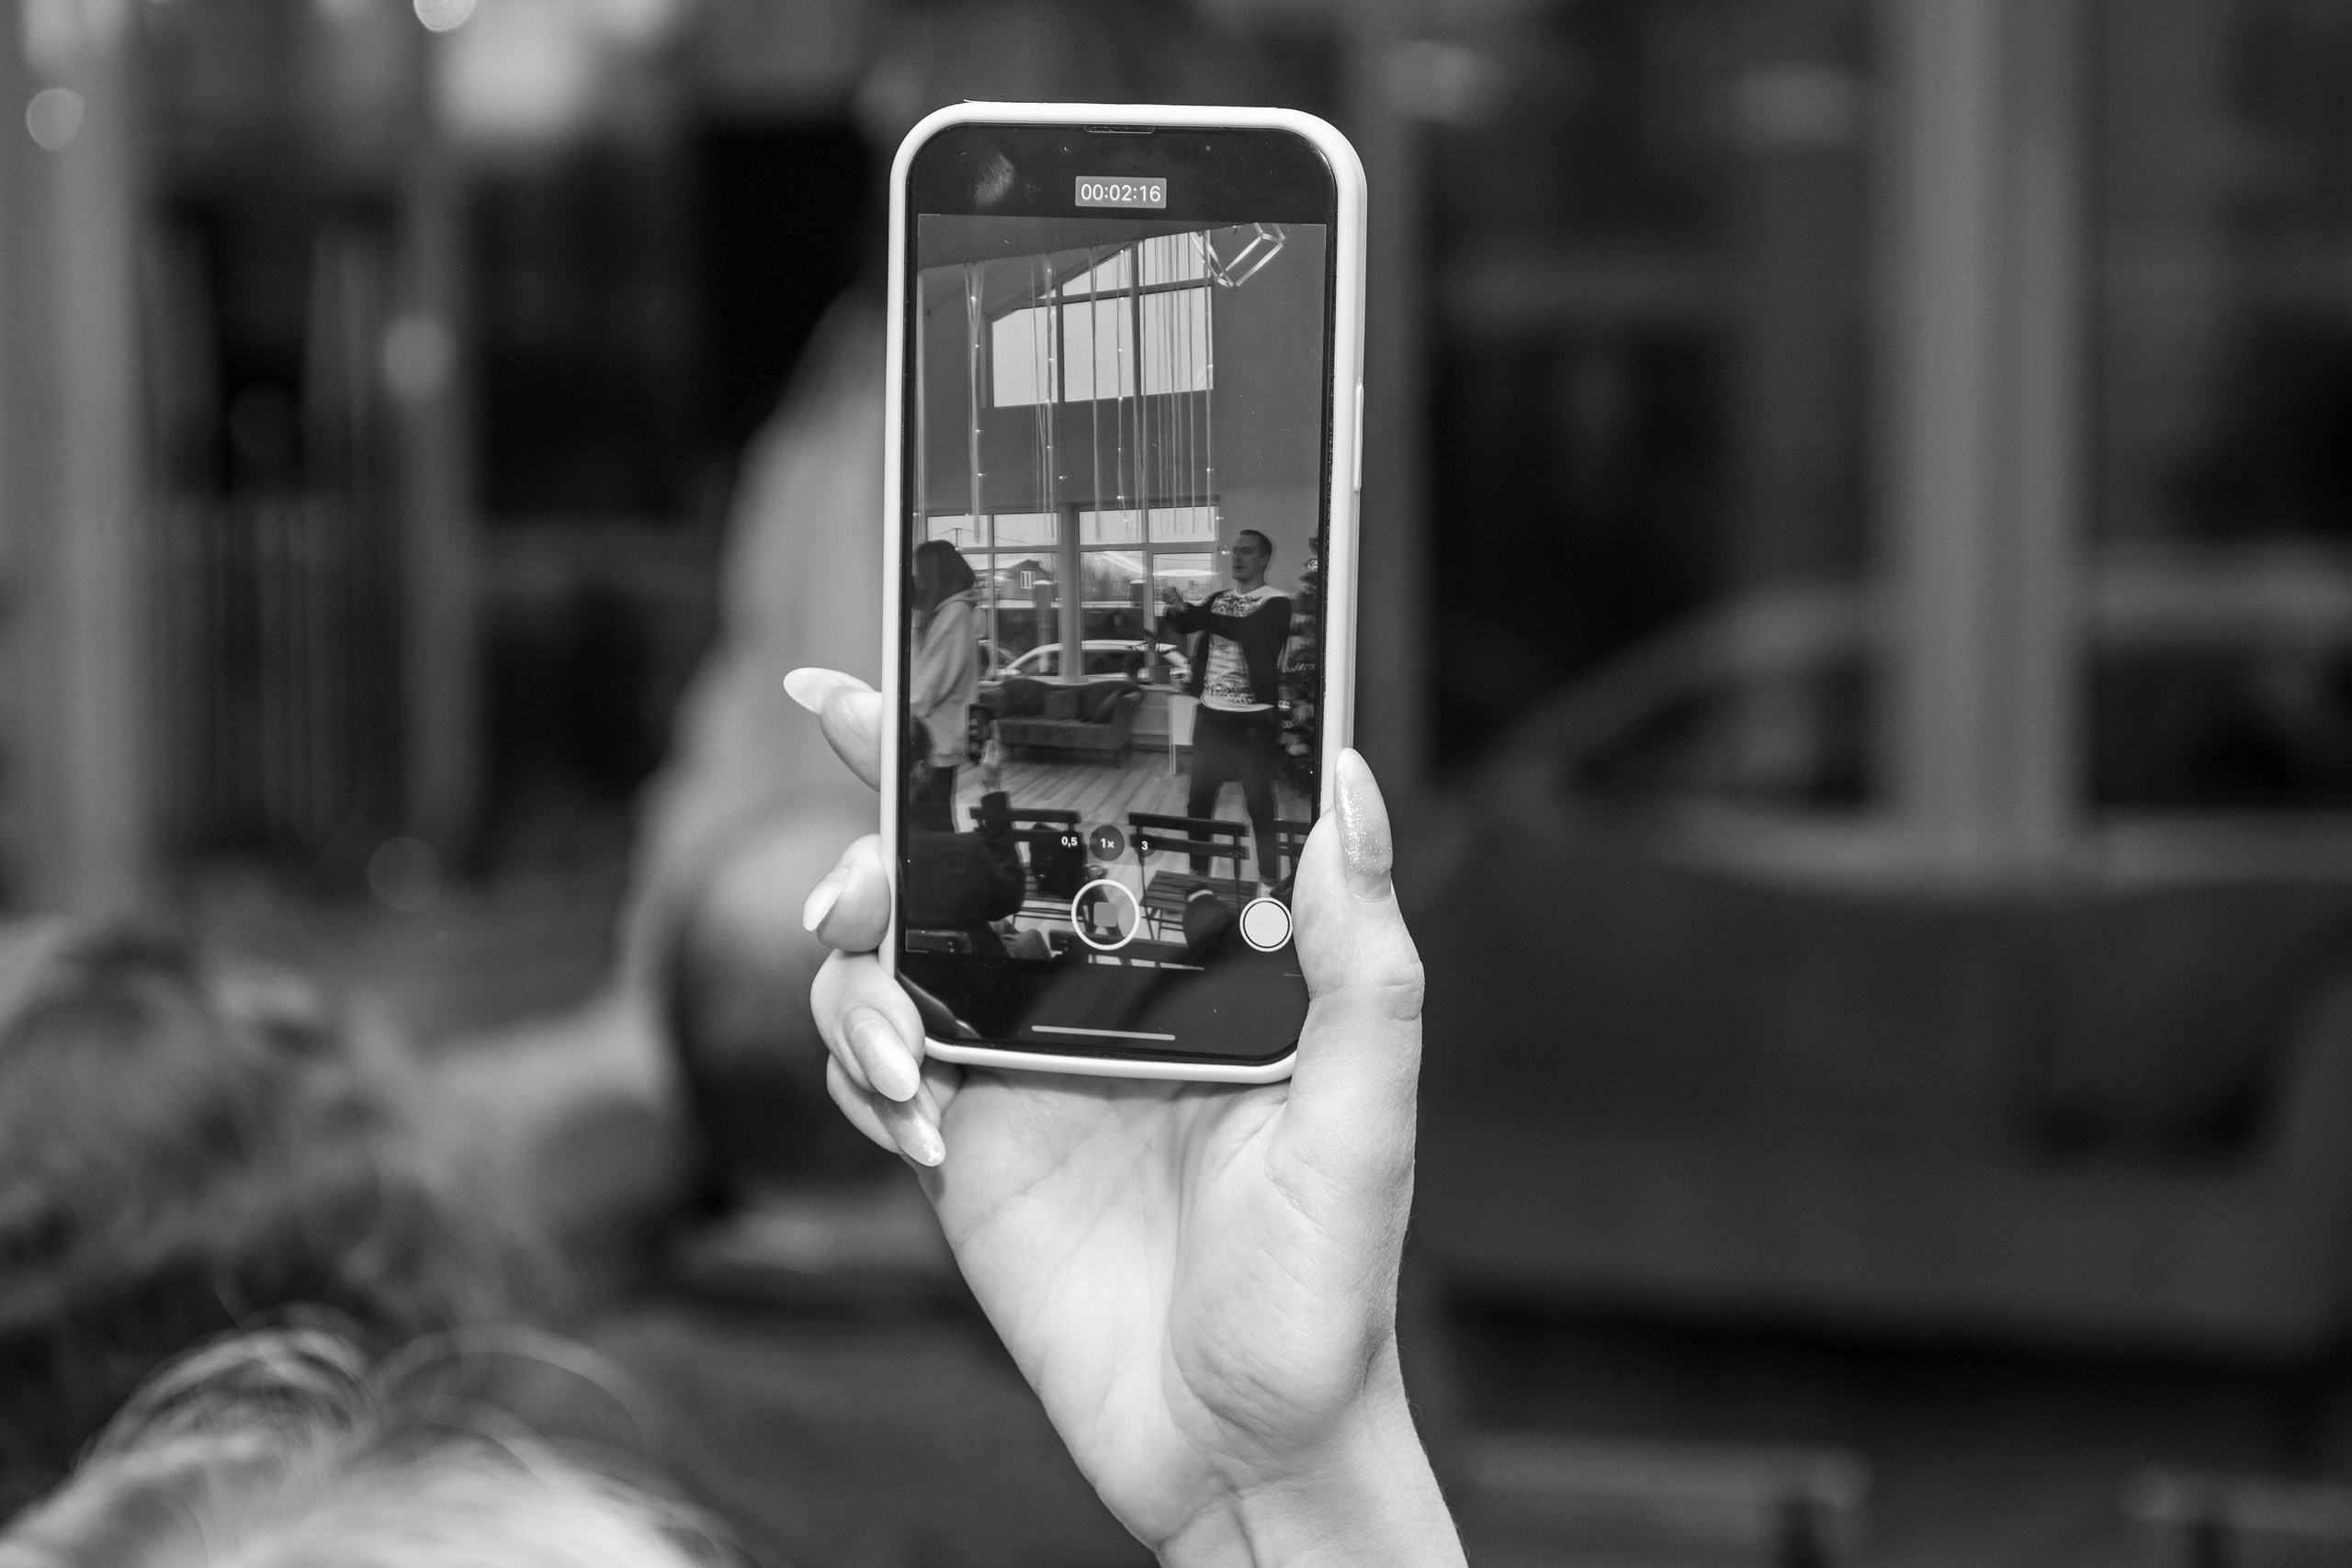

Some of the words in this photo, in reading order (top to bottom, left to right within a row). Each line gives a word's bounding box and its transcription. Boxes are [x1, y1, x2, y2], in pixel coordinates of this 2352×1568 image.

[1080, 183, 1161, 202] 00:02:16
[1061, 836, 1078, 848] 0,5
[1141, 840, 1148, 851] 3
